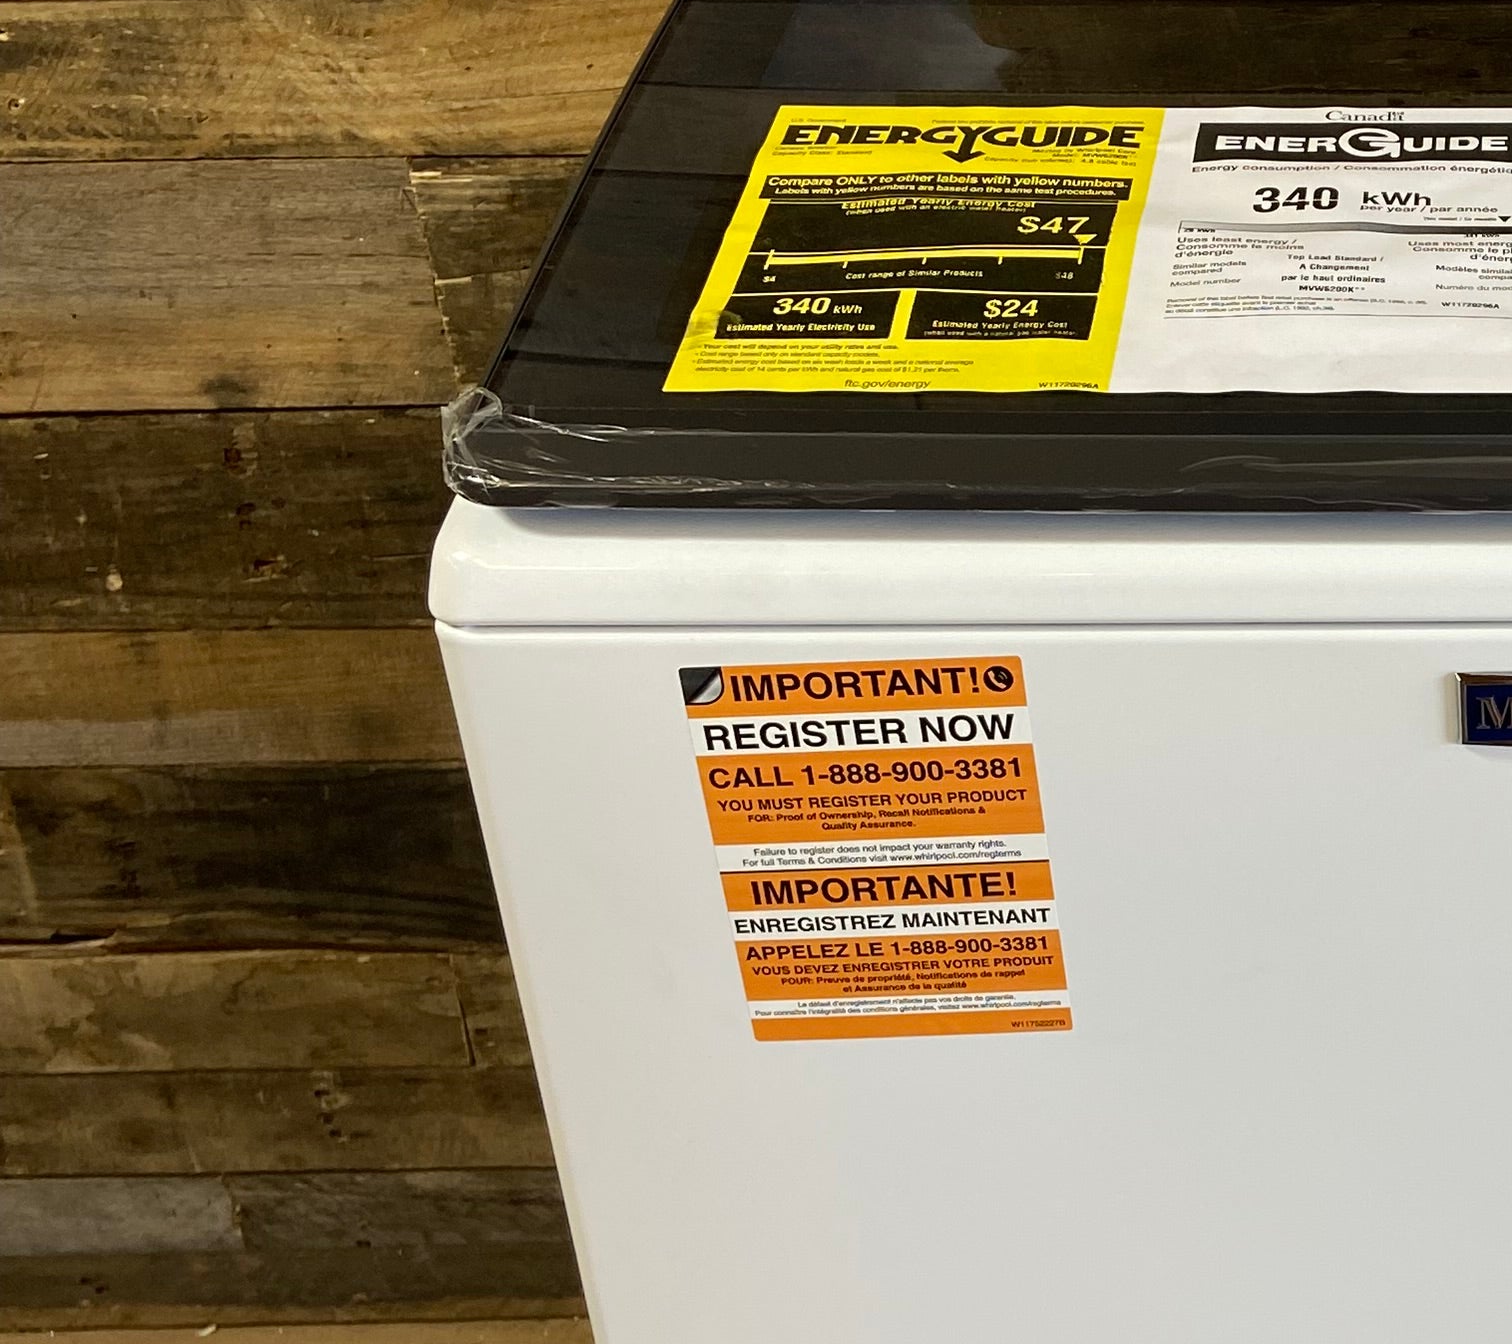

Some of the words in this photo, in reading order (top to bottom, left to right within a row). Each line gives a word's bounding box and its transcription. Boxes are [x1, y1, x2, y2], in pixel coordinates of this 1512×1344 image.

[1324, 109, 1406, 122] Canada
[780, 123, 1145, 153] ENERGYGUIDE
[1214, 127, 1510, 158] ENERGUIDE
[1191, 163, 1239, 174] Energy
[1242, 165, 1331, 173] consumption
[768, 175, 834, 188] Compare
[836, 175, 878, 186] ONLY
[879, 175, 893, 185] to
[896, 173, 933, 184] other
[936, 173, 979, 184] labels
[981, 175, 1012, 186] with
[1014, 175, 1060, 188] yellow
[1063, 177, 1128, 189] numbers.
[1252, 185, 1340, 214] 340
[1362, 190, 1433, 207] kWh
[1359, 204, 1384, 212] per
[1386, 205, 1418, 214] year
[1419, 205, 1427, 213] /
[1429, 205, 1453, 214] par
[1456, 205, 1499, 213] année
[1017, 215, 1090, 234] $47
[772, 296, 832, 315] 340
[833, 303, 863, 314] kWh
[983, 298, 1039, 320] $24
[726, 322, 773, 332] Estimated
[775, 323, 806, 334] Yearly
[807, 322, 856, 333] Electricity
[857, 322, 876, 331] Use
[932, 320, 979, 330] Estimated
[981, 320, 1010, 331] Yearly
[1012, 321, 1045, 332] Energy
[1046, 320, 1069, 330] Cost
[843, 378, 932, 390] ftc.gov/energy
[729, 666, 980, 702] IMPORTANT!
[703, 718, 908, 751] REGISTER
[919, 713, 1015, 744] NOW
[708, 765, 795, 789] CALL
[800, 757, 1022, 787] 1-888-900-3381
[716, 799, 754, 812] YOU
[758, 797, 803, 811] MUST
[808, 794, 892, 810] REGISTER
[896, 792, 944, 806] YOUR
[946, 788, 1028, 805] PRODUCT
[749, 871, 1018, 906] IMPORTANTE!
[733, 914, 896, 935] ENREGISTREZ
[901, 907, 1051, 930] MAINTENANT
[745, 941, 850, 961] APPELEZ
[855, 941, 885, 957] LE
[890, 935, 1049, 957] 1-888-900-3381
[751, 964, 791, 976] VOUS
[794, 962, 840, 974] DEVEZ
[842, 959, 941, 974] ENREGISTRER
[943, 957, 991, 970] VOTRE
[993, 954, 1055, 968] PRODUIT
